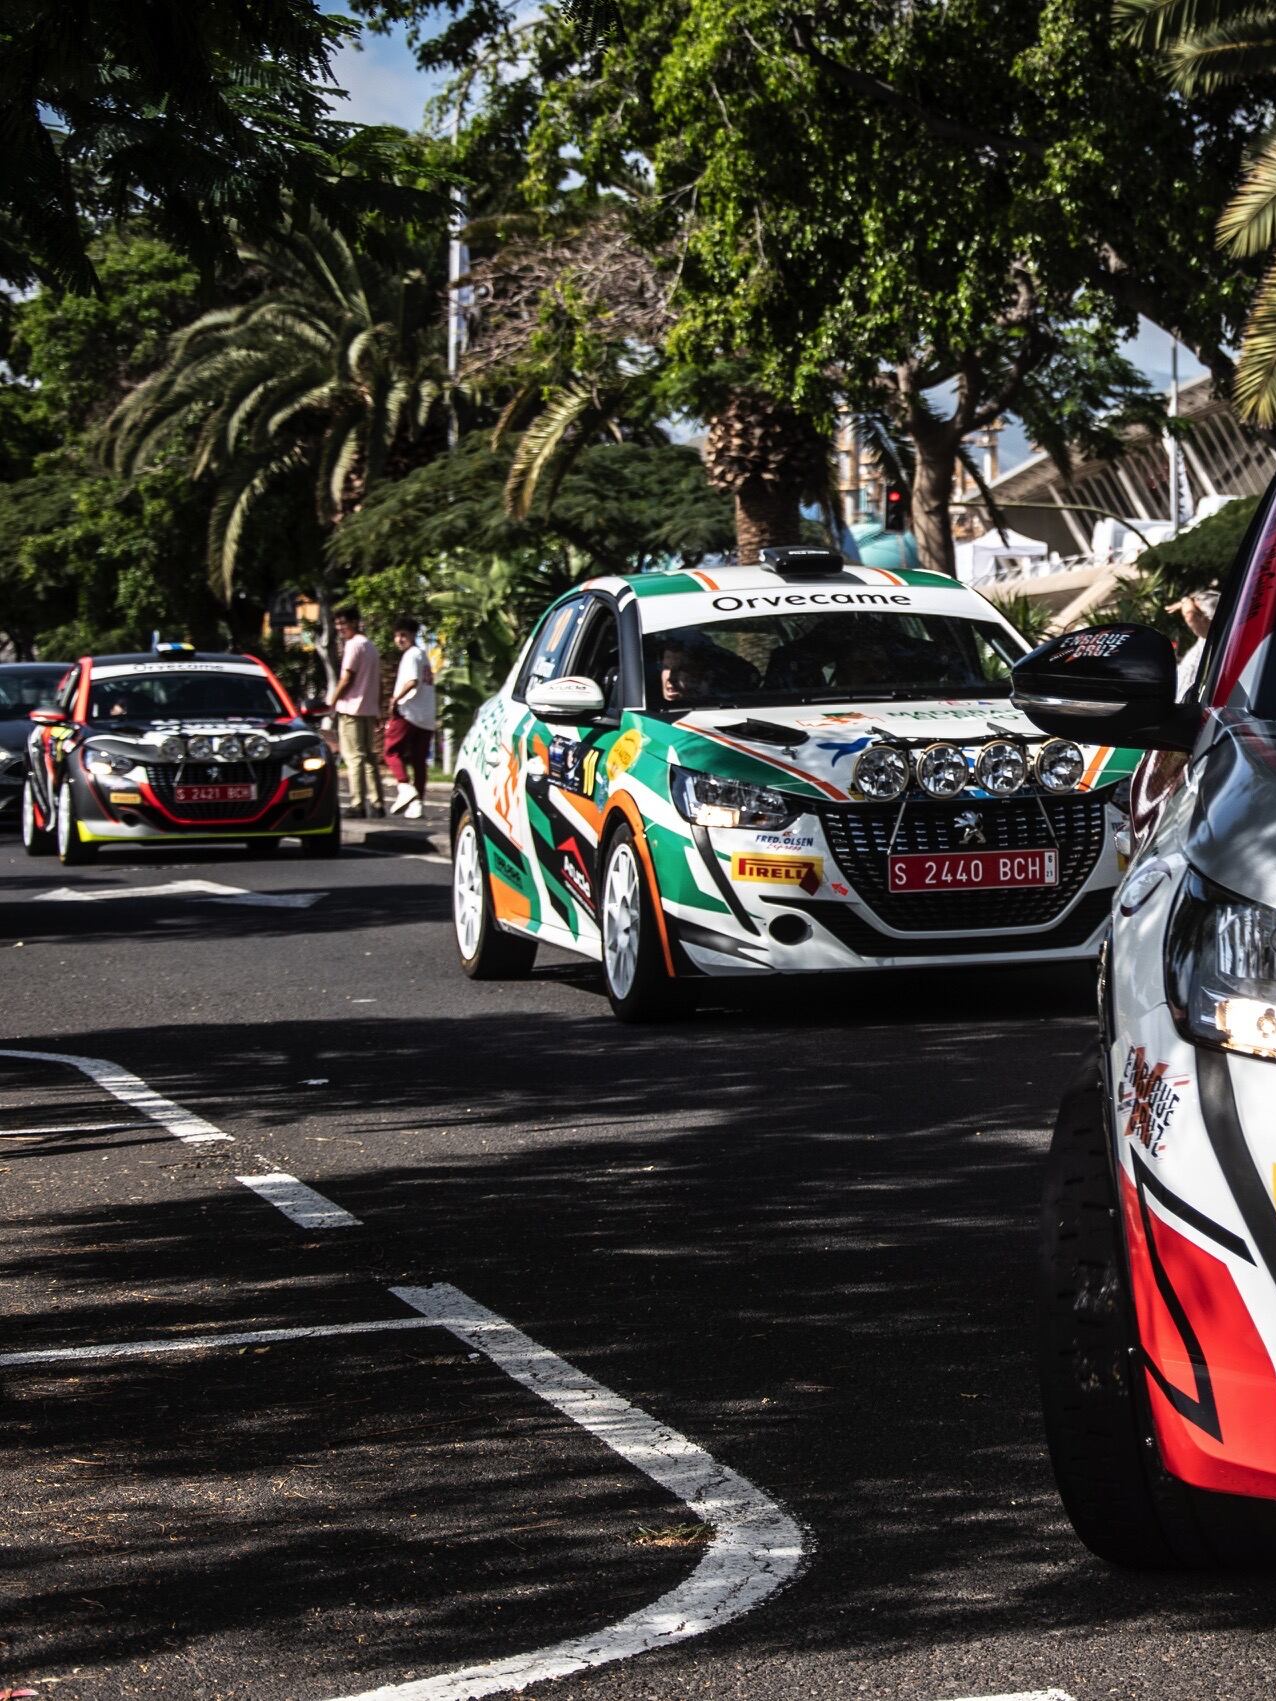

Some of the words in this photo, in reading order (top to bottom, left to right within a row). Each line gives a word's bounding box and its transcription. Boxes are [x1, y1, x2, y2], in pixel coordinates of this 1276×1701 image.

[712, 592, 911, 611] Orvecame
[1060, 633, 1130, 647] ENRIQUE
[1073, 644, 1118, 658] CRUZ
[784, 837, 814, 847] OLSEN
[738, 857, 815, 882] PIRELL
[894, 863, 907, 885] S
[925, 859, 983, 884] 2440
[1000, 857, 1040, 881] BCH
